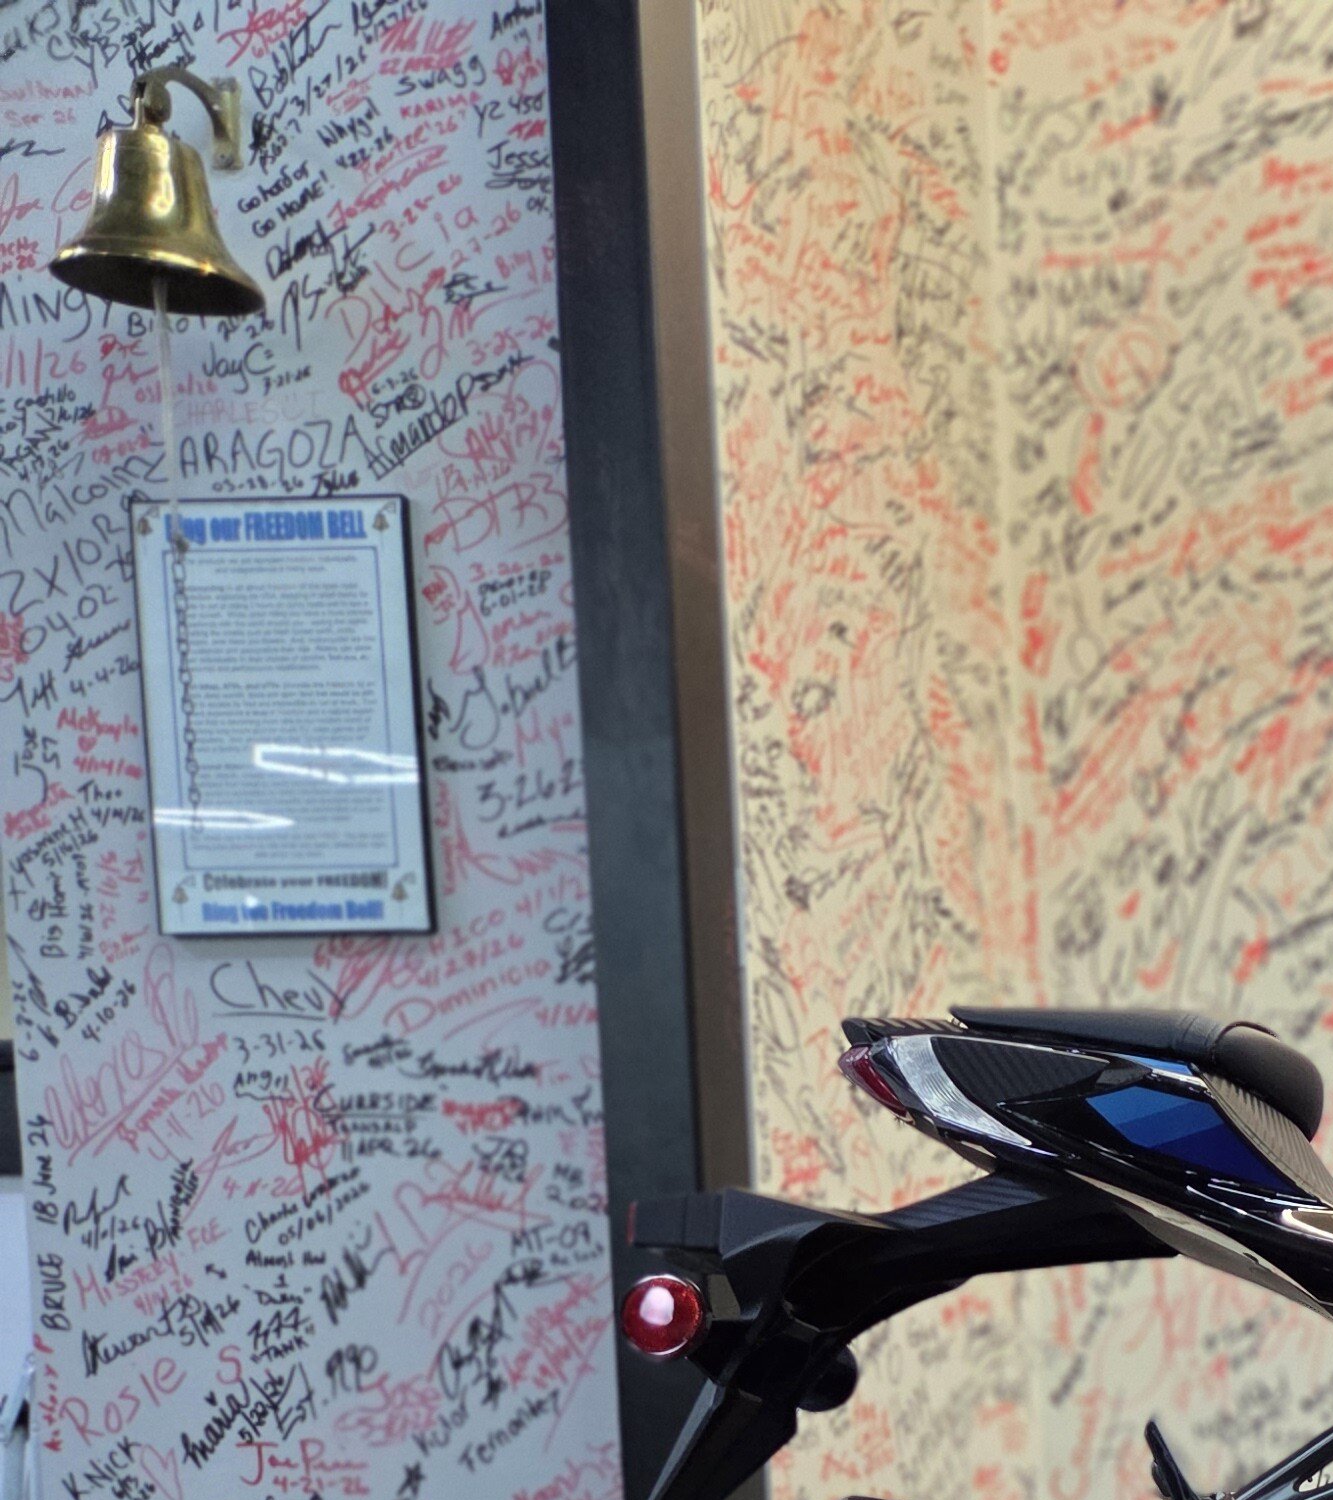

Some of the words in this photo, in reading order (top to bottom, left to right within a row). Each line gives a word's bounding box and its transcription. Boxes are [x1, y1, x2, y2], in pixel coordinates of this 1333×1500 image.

[210, 518, 241, 541] our
[244, 511, 324, 541] FREEDOM
[327, 510, 367, 538] BELL
[271, 901, 343, 920] Freedom
[37, 1252, 71, 1332] BRUCE
